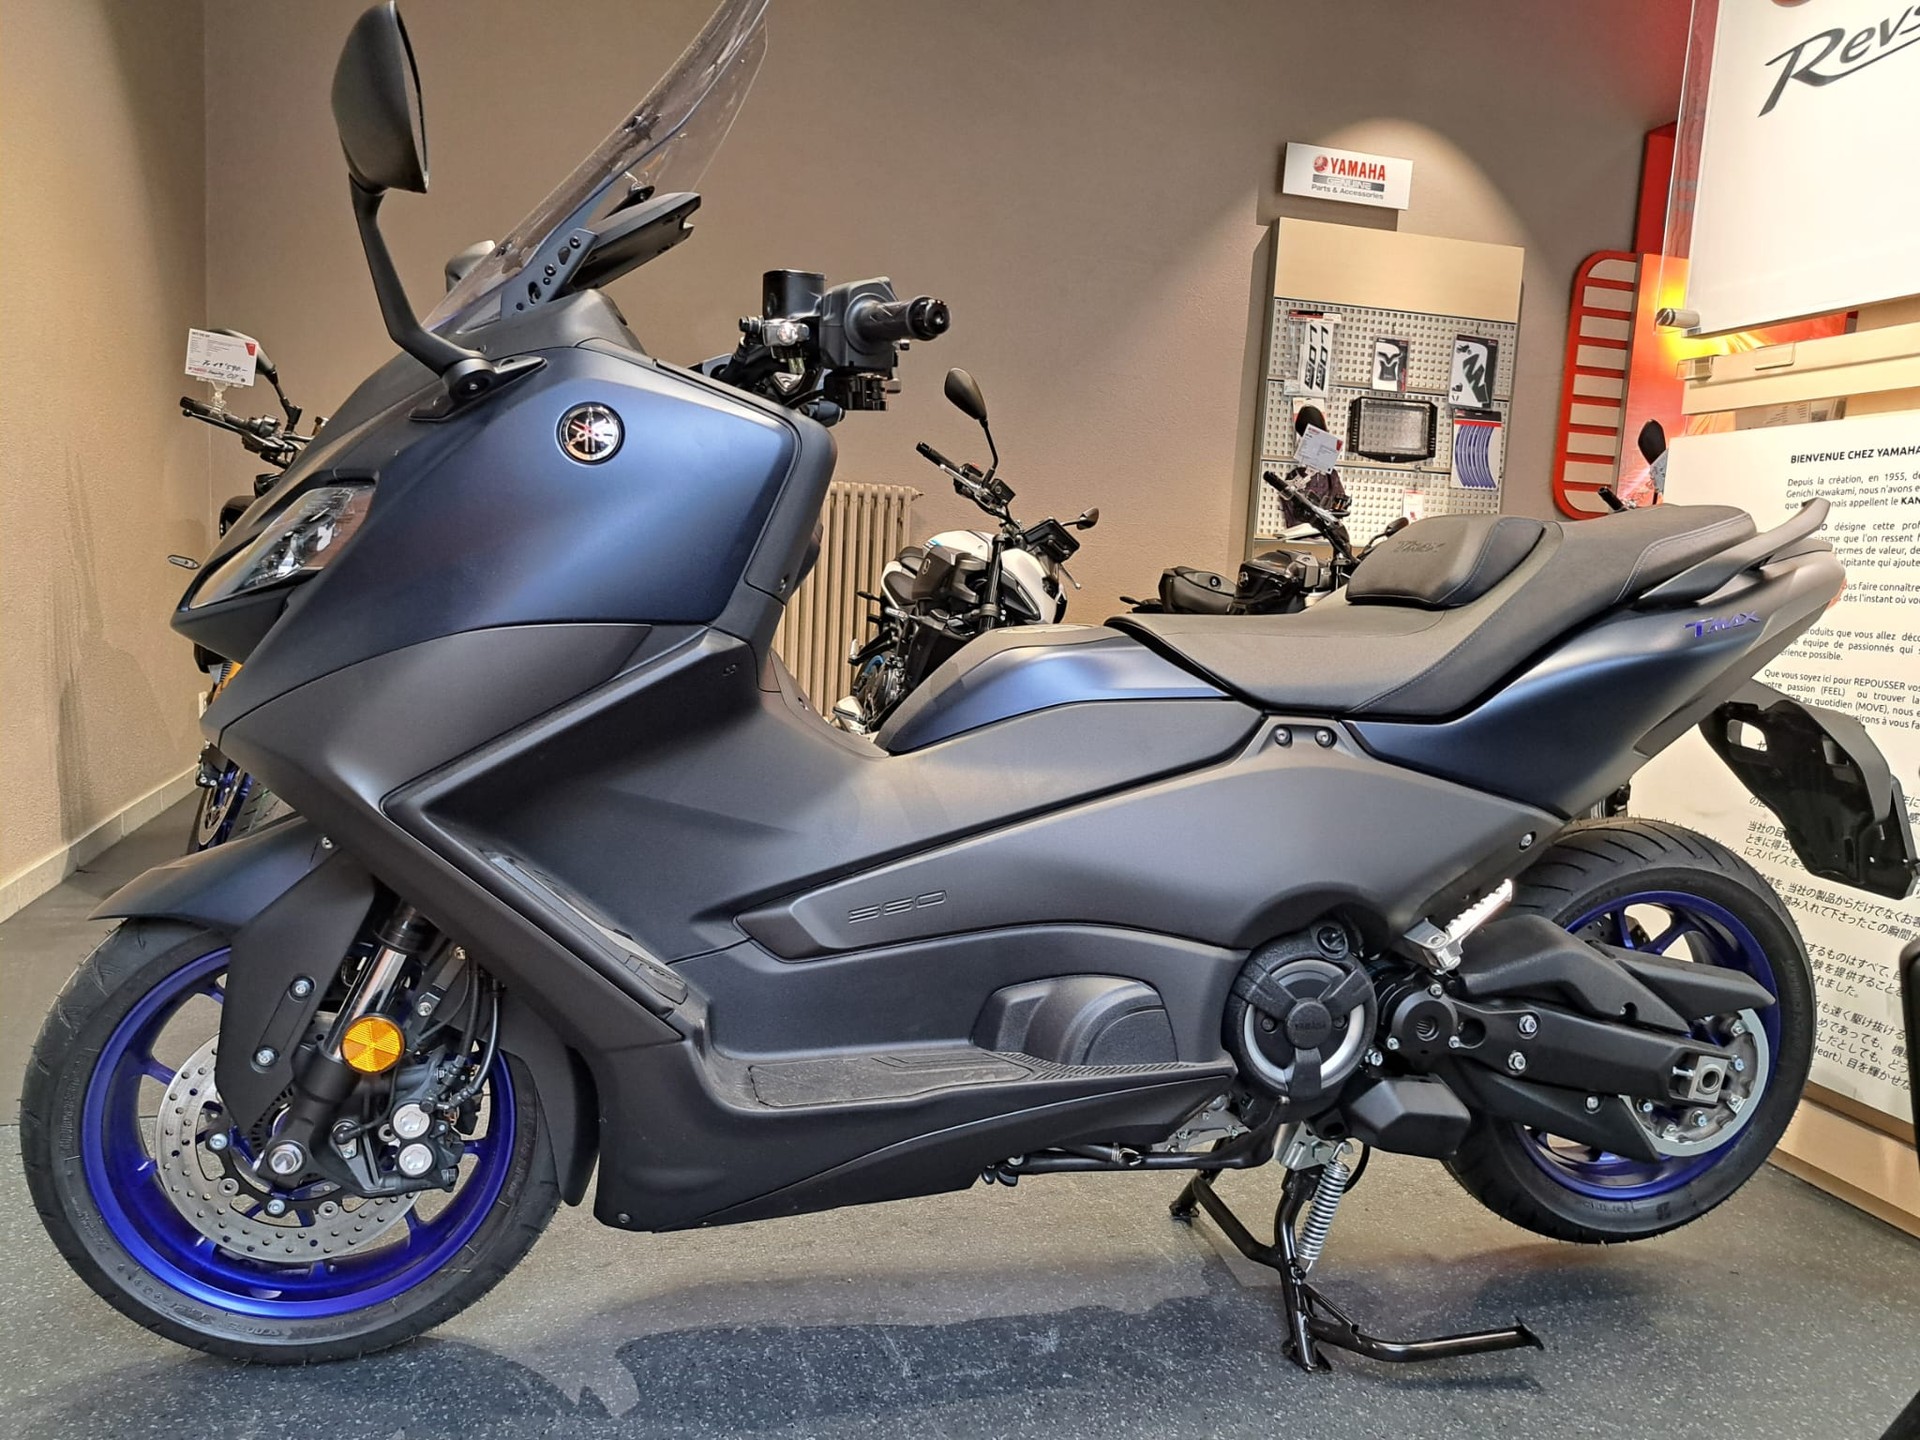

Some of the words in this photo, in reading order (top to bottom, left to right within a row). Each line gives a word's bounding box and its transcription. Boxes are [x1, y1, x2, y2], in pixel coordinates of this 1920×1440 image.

[1331, 157, 1386, 181] YAMAHA
[1327, 177, 1372, 190] GENUINE
[1311, 184, 1331, 193] Parts
[1340, 188, 1384, 200] Accessories
[1790, 451, 1845, 464] BIENVENUE
[1847, 449, 1874, 459] CHEZ
[1877, 445, 1920, 457] YAMAHA
[1787, 478, 1813, 487] Depuis
[1817, 476, 1824, 485] la
[1828, 475, 1863, 485] création,
[1885, 472, 1907, 481] 1955,
[1786, 488, 1814, 498] Genichi
[1815, 487, 1857, 497] Kawakami,
[1859, 487, 1878, 495] nous
[1880, 485, 1912, 494] n'avons
[1785, 501, 1799, 510] que
[1831, 499, 1847, 507] nais
[1849, 498, 1888, 508] appellent
[1891, 497, 1899, 505] le
[1834, 522, 1866, 532] désigne
[1872, 522, 1895, 531] cette
[1843, 536, 1859, 544] que
[1862, 534, 1878, 542] l'on
[1881, 534, 1913, 542] ressent
[1834, 547, 1863, 555] termes
[1865, 545, 1876, 554] de
[1878, 545, 1907, 556] valeur,
[1841, 558, 1876, 568] lpitante
[1877, 558, 1891, 568] qui
[1843, 583, 1857, 591] ous
[1858, 582, 1878, 590] faire
[1843, 593, 1858, 602] dès
[1859, 594, 1893, 603] l'instant
[1895, 595, 1906, 604] où
[1807, 626, 1834, 637] oduits
[1836, 630, 1852, 639] que
[1854, 631, 1873, 639] vous
[1876, 630, 1896, 641] allez
[1802, 638, 1830, 649] équipe
[1833, 639, 1844, 649] de
[1848, 642, 1894, 653] passionnés
[1899, 645, 1914, 655] qui
[1781, 648, 1808, 658] rience
[1808, 651, 1843, 661] possible.
[1764, 669, 1780, 679] Que
[1781, 671, 1799, 680] vous
[1799, 673, 1821, 683] soyez
[1822, 674, 1832, 683] ici
[1833, 676, 1852, 686] pour
[1853, 677, 1906, 690] REPOUSSER
[1787, 683, 1816, 693] passion
[1821, 685, 1846, 697] (FEEL)
[1856, 691, 1868, 699] ou
[1873, 692, 1906, 703] trouver
[1911, 694, 1920, 705] la
[1814, 697, 1853, 709] quotidien
[1855, 700, 1889, 715] (MOVE),
[1892, 707, 1914, 717] nous
[1889, 719, 1910, 729] vous
[1813, 974, 1859, 999] れました。
